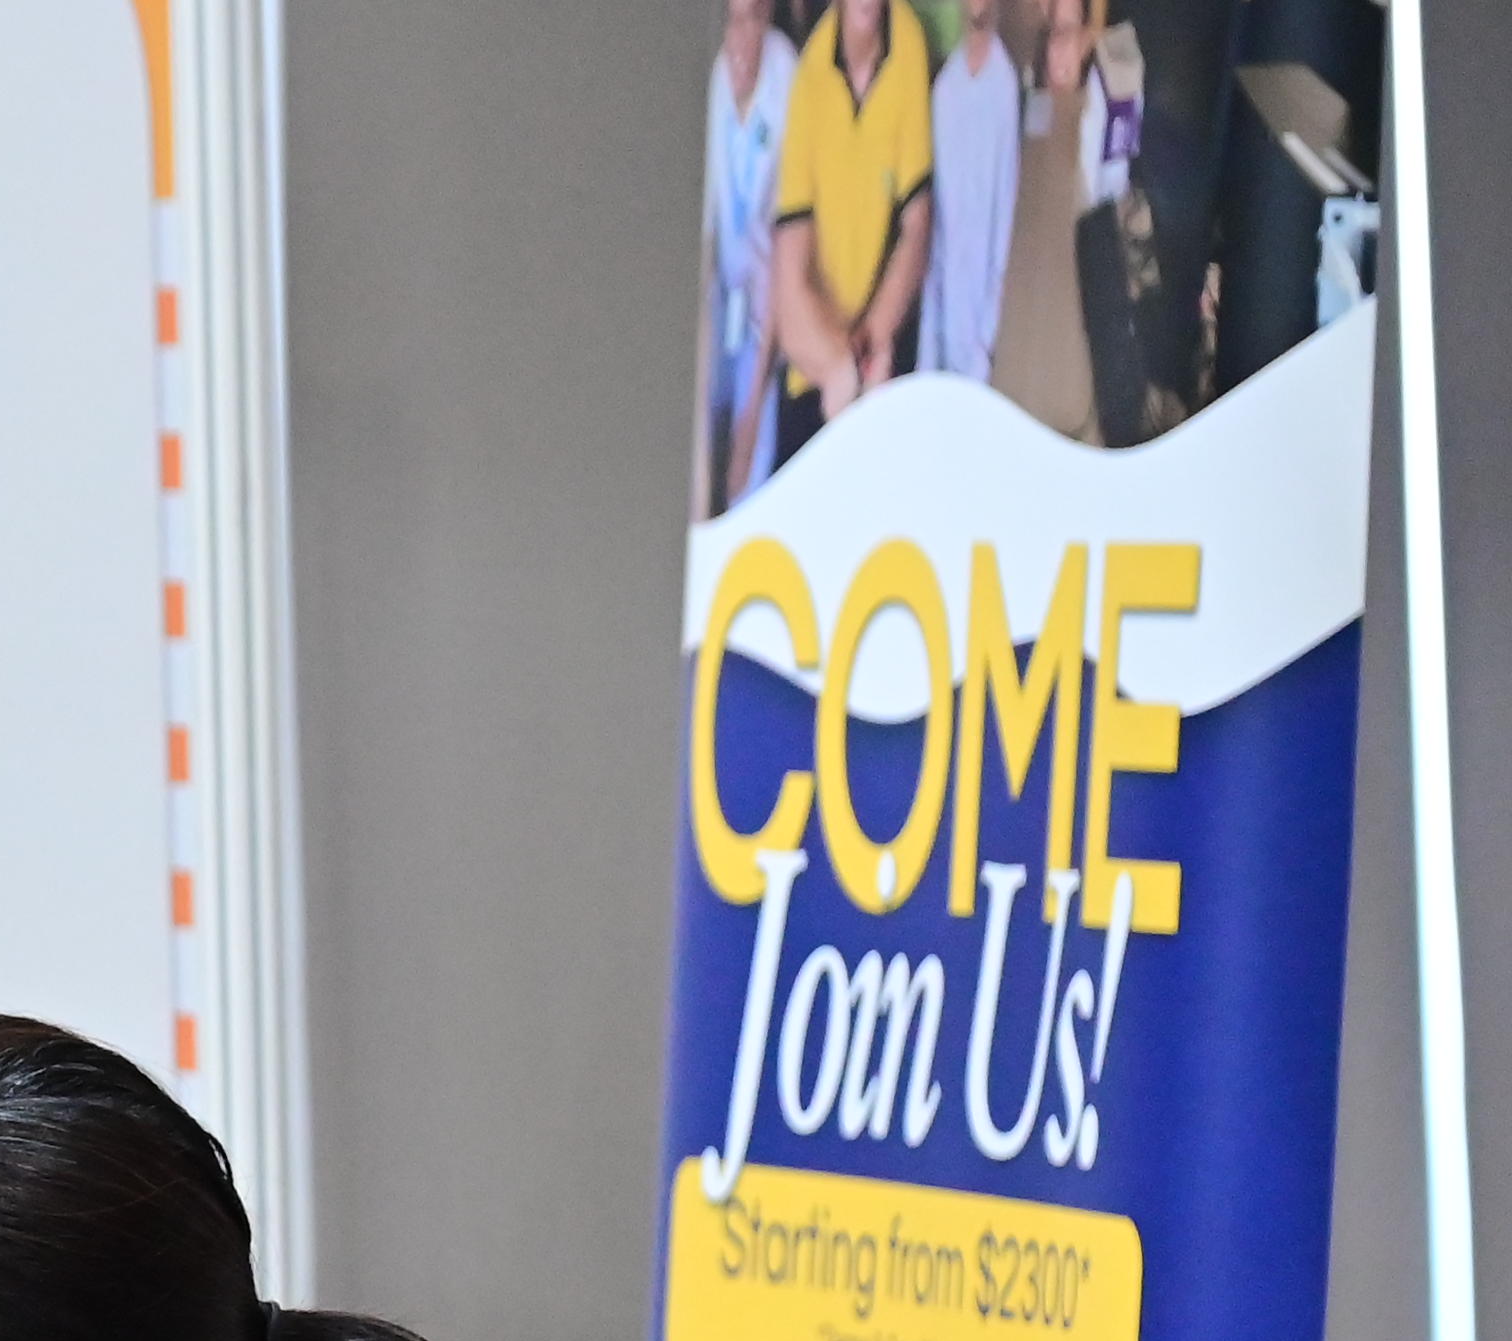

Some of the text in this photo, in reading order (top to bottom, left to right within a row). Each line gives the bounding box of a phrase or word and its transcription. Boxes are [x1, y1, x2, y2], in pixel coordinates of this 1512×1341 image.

[689, 534, 1202, 934] COME
[702, 848, 1132, 1201] Join Us!
[721, 1199, 878, 1320] Starting
[887, 1213, 966, 1310] from
